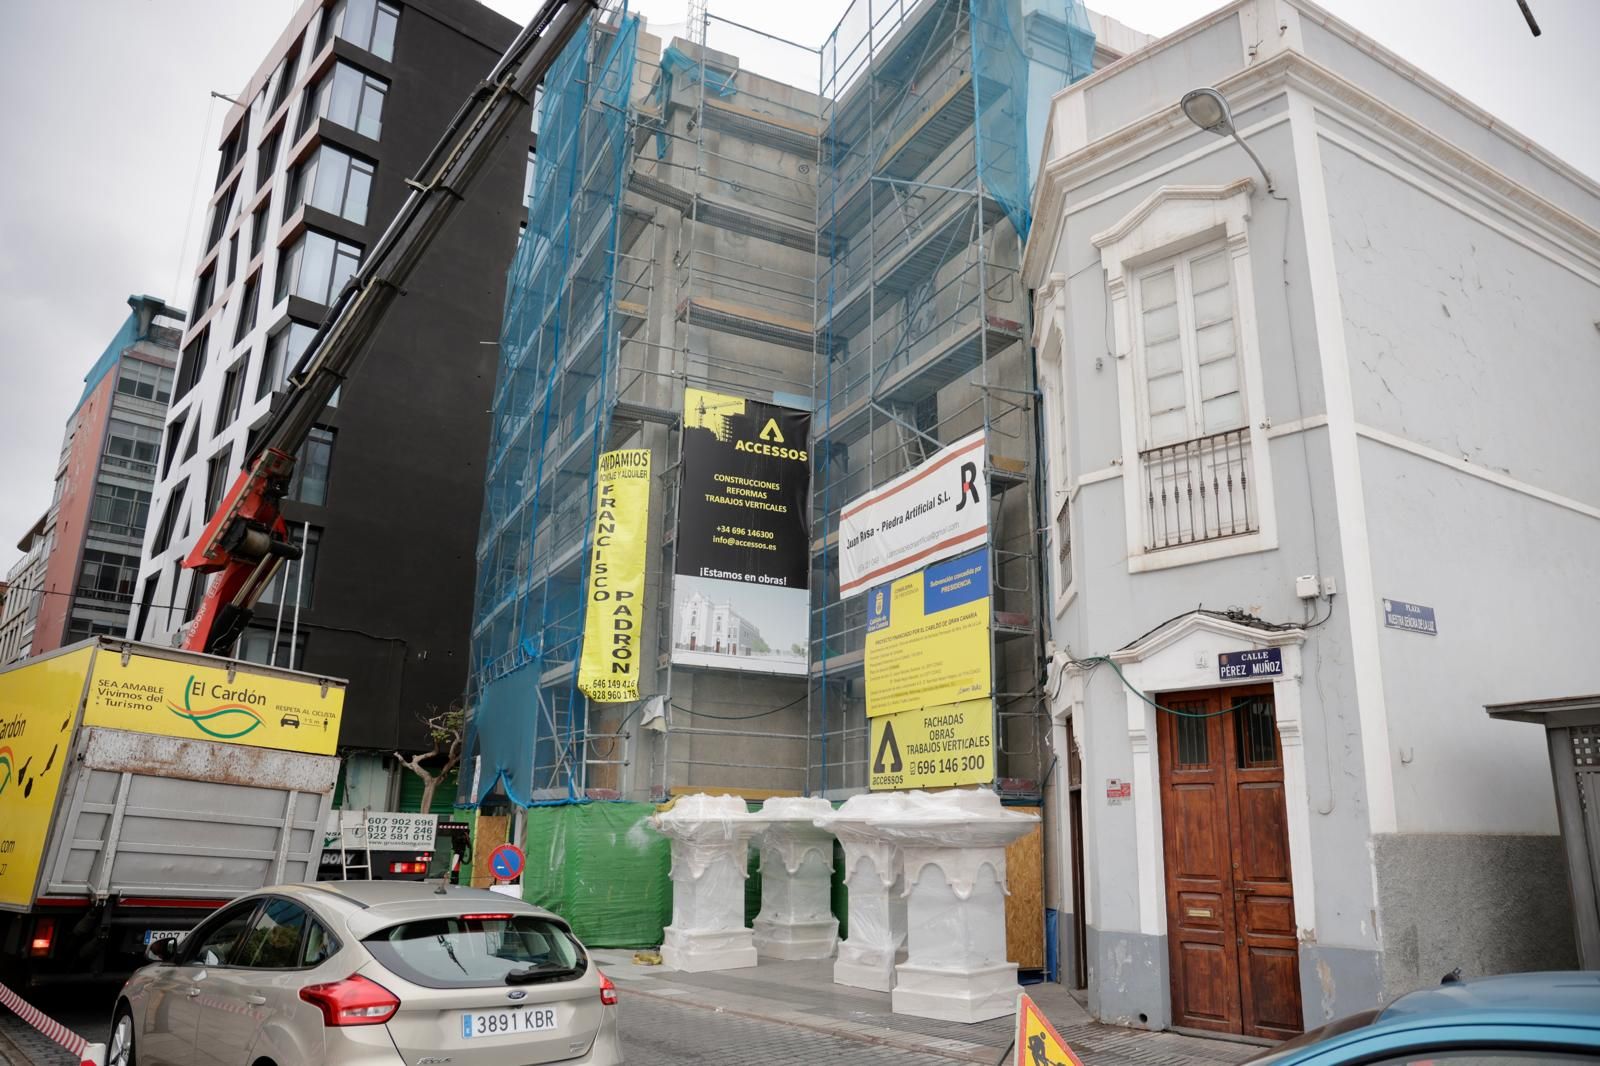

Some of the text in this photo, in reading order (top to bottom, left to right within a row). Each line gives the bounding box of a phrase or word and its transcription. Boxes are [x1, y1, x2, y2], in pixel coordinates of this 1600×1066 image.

[735, 440, 807, 462] ACCESSOS
[600, 452, 648, 472] ANDAMIOS
[713, 473, 780, 491] CONSTRUCCIONES
[726, 486, 768, 499] REFORMAS
[705, 494, 787, 513] TRABAJOS VERTICALES
[846, 535, 860, 550] Juan
[881, 514, 904, 532] Piedra
[905, 498, 935, 522] Artificial
[937, 490, 951, 506] S.L.
[716, 525, 774, 539] +34 696 146300
[593, 485, 616, 602] FRANCISCO
[712, 535, 777, 551] info@accessos.es
[700, 567, 787, 586] ¡Estamos en obras!
[612, 591, 634, 674] PADRÓN
[1241, 651, 1269, 661] CALLE
[1220, 660, 1281, 678] PÉREZ MUÑOZ
[98, 679, 164, 694] SEA AMABLE
[593, 680, 606, 688] 646
[608, 680, 621, 689] 149
[98, 687, 163, 703] Vivimos del
[191, 681, 267, 706] El Cardón
[592, 691, 606, 699] 928
[607, 691, 622, 699] 960
[105, 699, 153, 711] Turismo
[275, 704, 301, 714] RESPETA
[923, 713, 964, 729] FACHADAS
[929, 728, 955, 741] OBRAS
[907, 735, 990, 755] TRABAJOS VERTICALES
[917, 754, 985, 775] 696 146 300
[872, 775, 904, 786] accessos
[367, 825, 433, 834] 610 757 246
[368, 817, 434, 827] 607 902 696
[390, 833, 409, 841] 581
[477, 1009, 554, 1034] 3891 KBR
